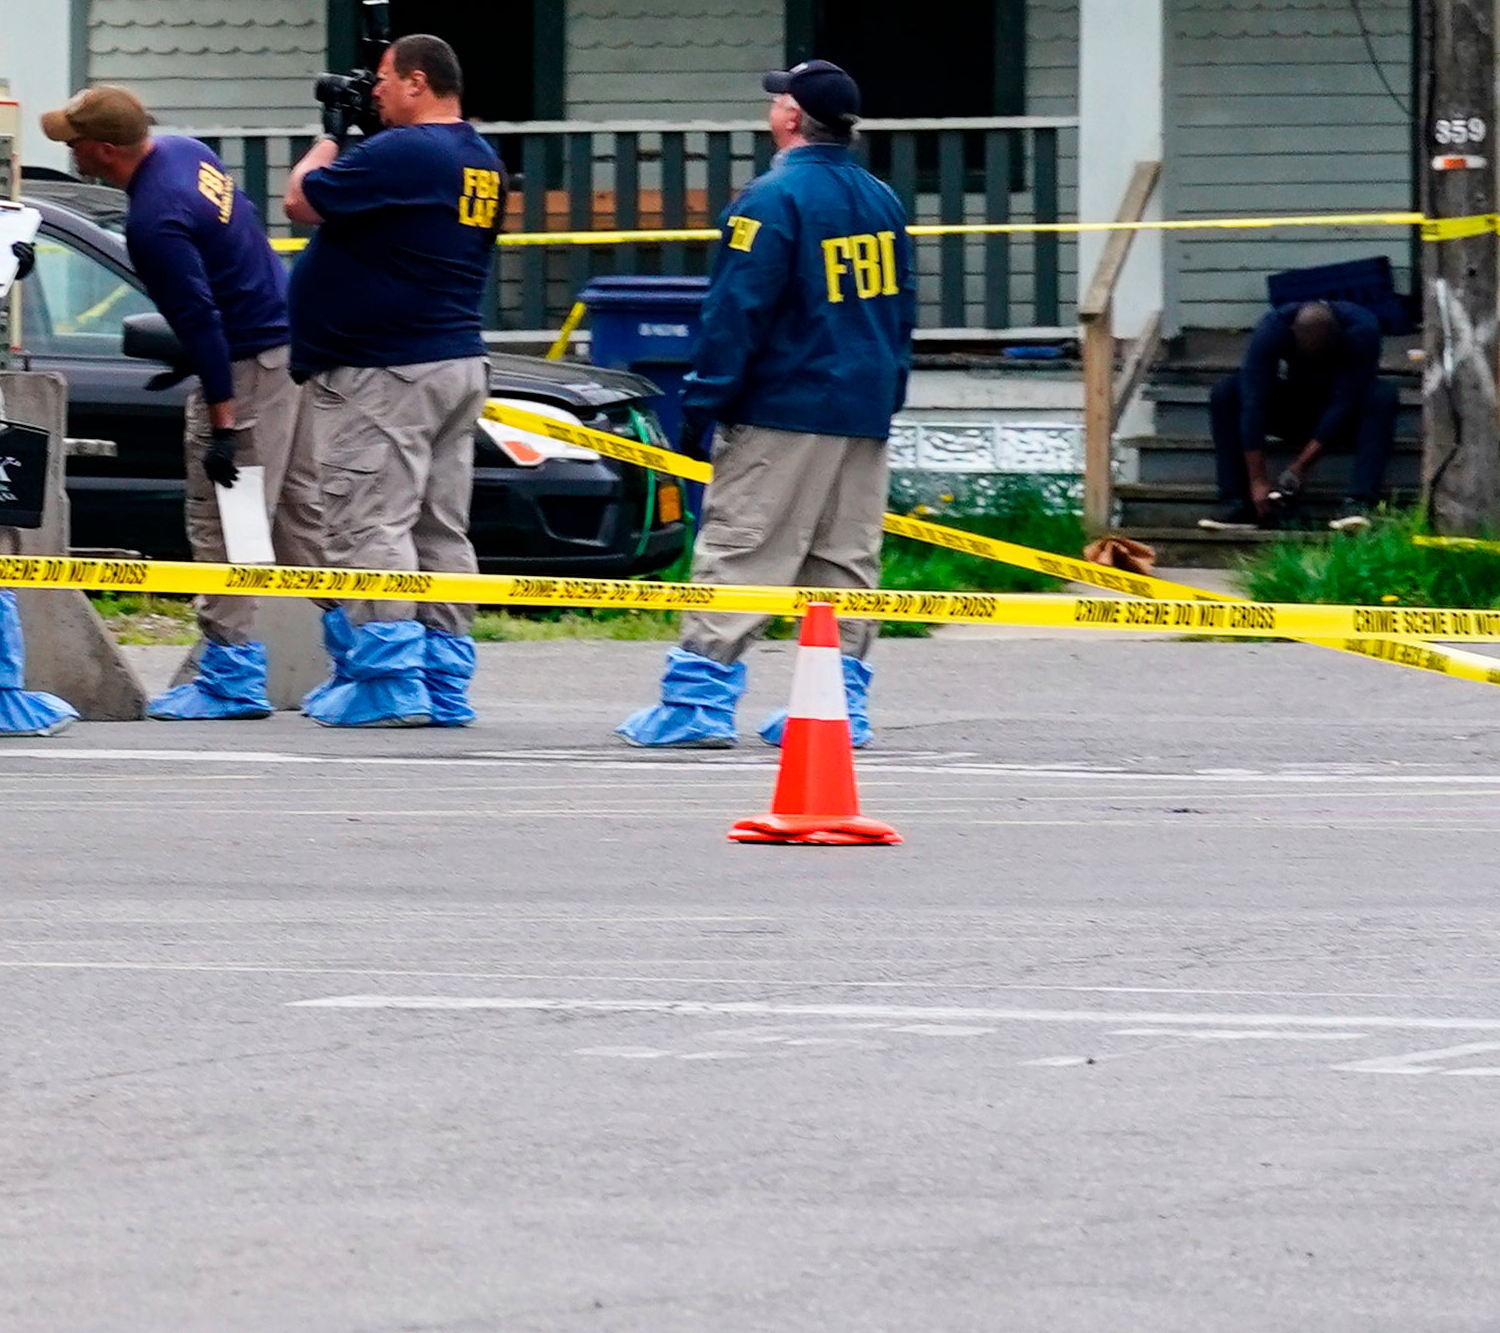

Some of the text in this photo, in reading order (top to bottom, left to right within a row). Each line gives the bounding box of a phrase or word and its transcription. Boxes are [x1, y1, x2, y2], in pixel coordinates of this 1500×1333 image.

[821, 230, 900, 303] FBI
[41, 559, 65, 583] DO
[67, 560, 99, 584] NOT
[98, 561, 150, 585] CROSS
[225, 566, 437, 594] CRIME SCENE DO NOT CROSS
[1074, 598, 1276, 629] CRIME SCENE DO NOT CROSS
[1353, 608, 1399, 634] CRIME
[1402, 610, 1448, 634] SCENE
[1451, 611, 1471, 635] DO
